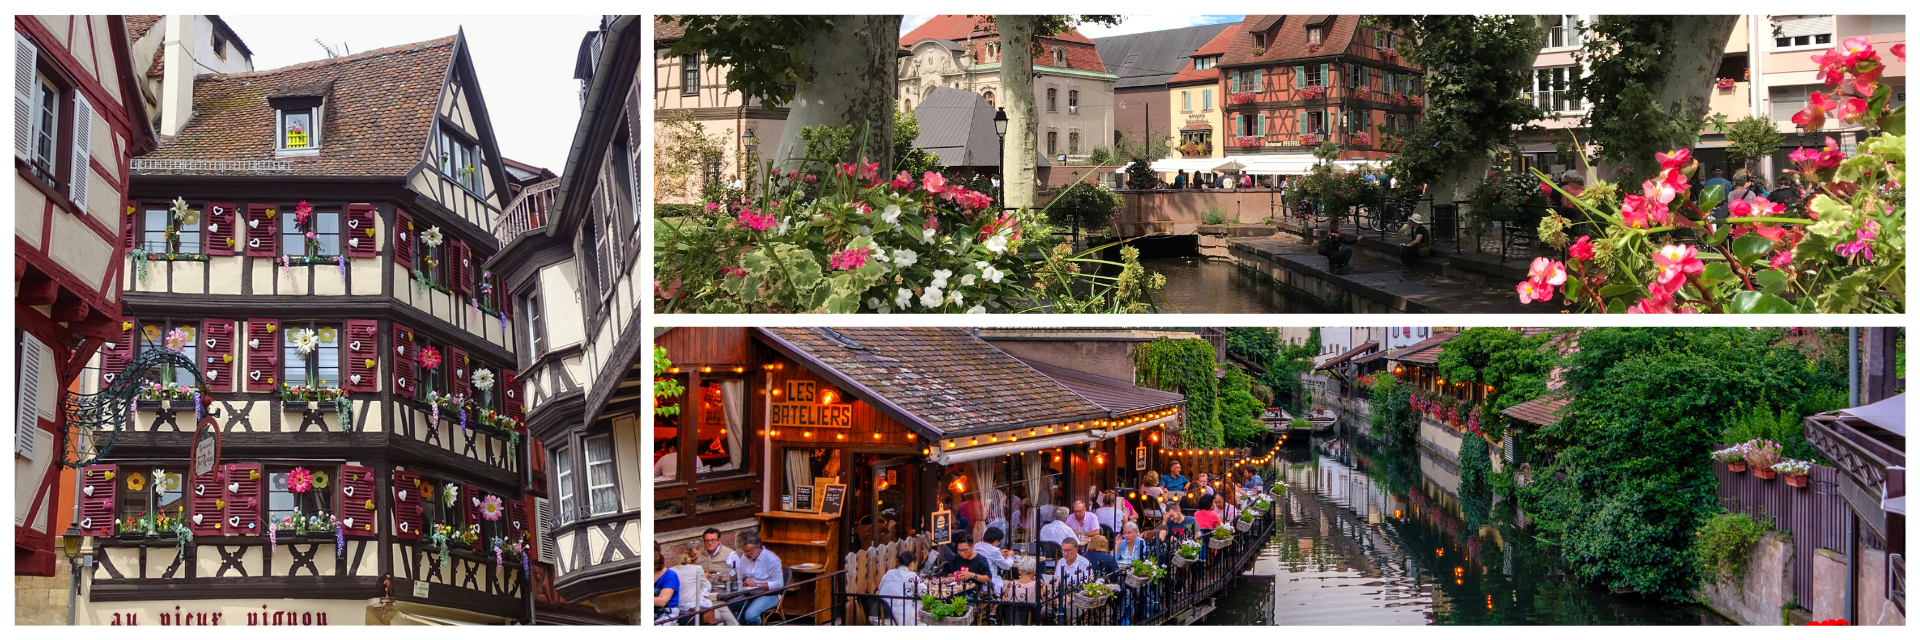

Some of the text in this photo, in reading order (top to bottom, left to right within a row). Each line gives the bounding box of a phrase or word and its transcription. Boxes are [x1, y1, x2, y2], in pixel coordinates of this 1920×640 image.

[788, 382, 814, 402] LES
[772, 405, 850, 426] BATELIERS
[111, 612, 137, 626] au
